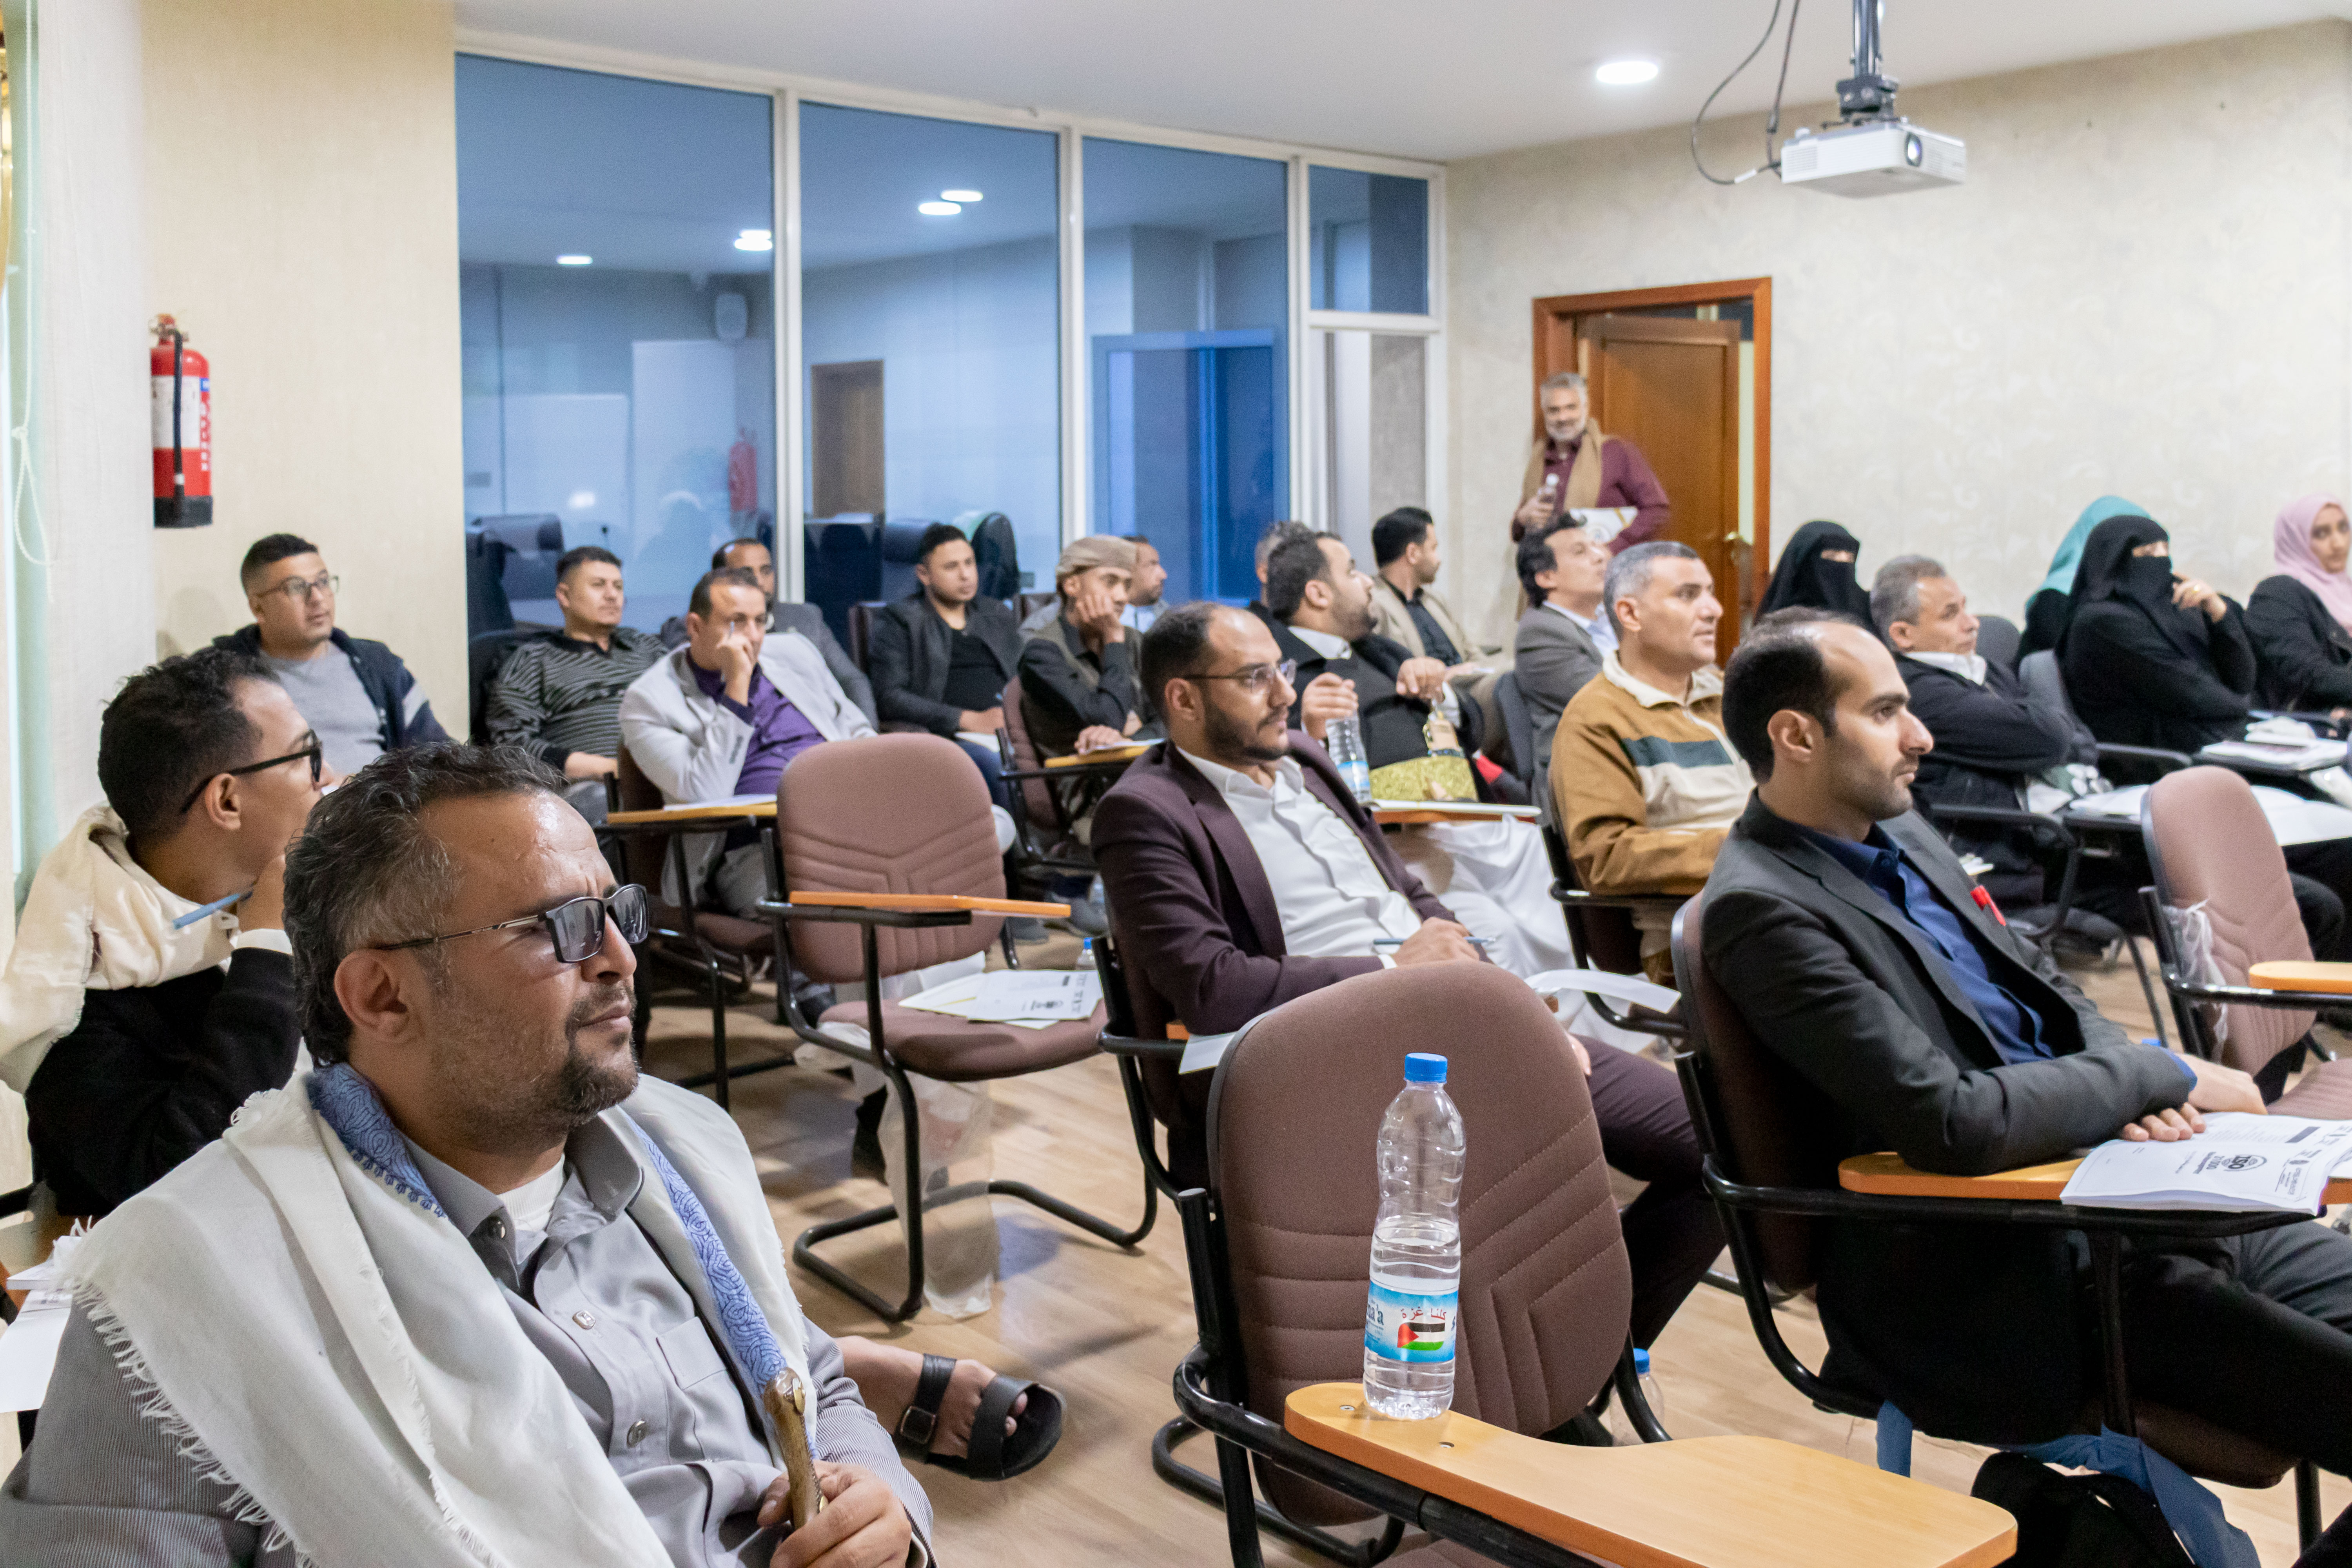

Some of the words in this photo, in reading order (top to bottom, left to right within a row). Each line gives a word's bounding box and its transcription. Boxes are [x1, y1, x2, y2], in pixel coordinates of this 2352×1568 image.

[2229, 1156, 2251, 1169] ISO
[1401, 1307, 1423, 1320] غزة
[1431, 1308, 1446, 1320] كلنا
